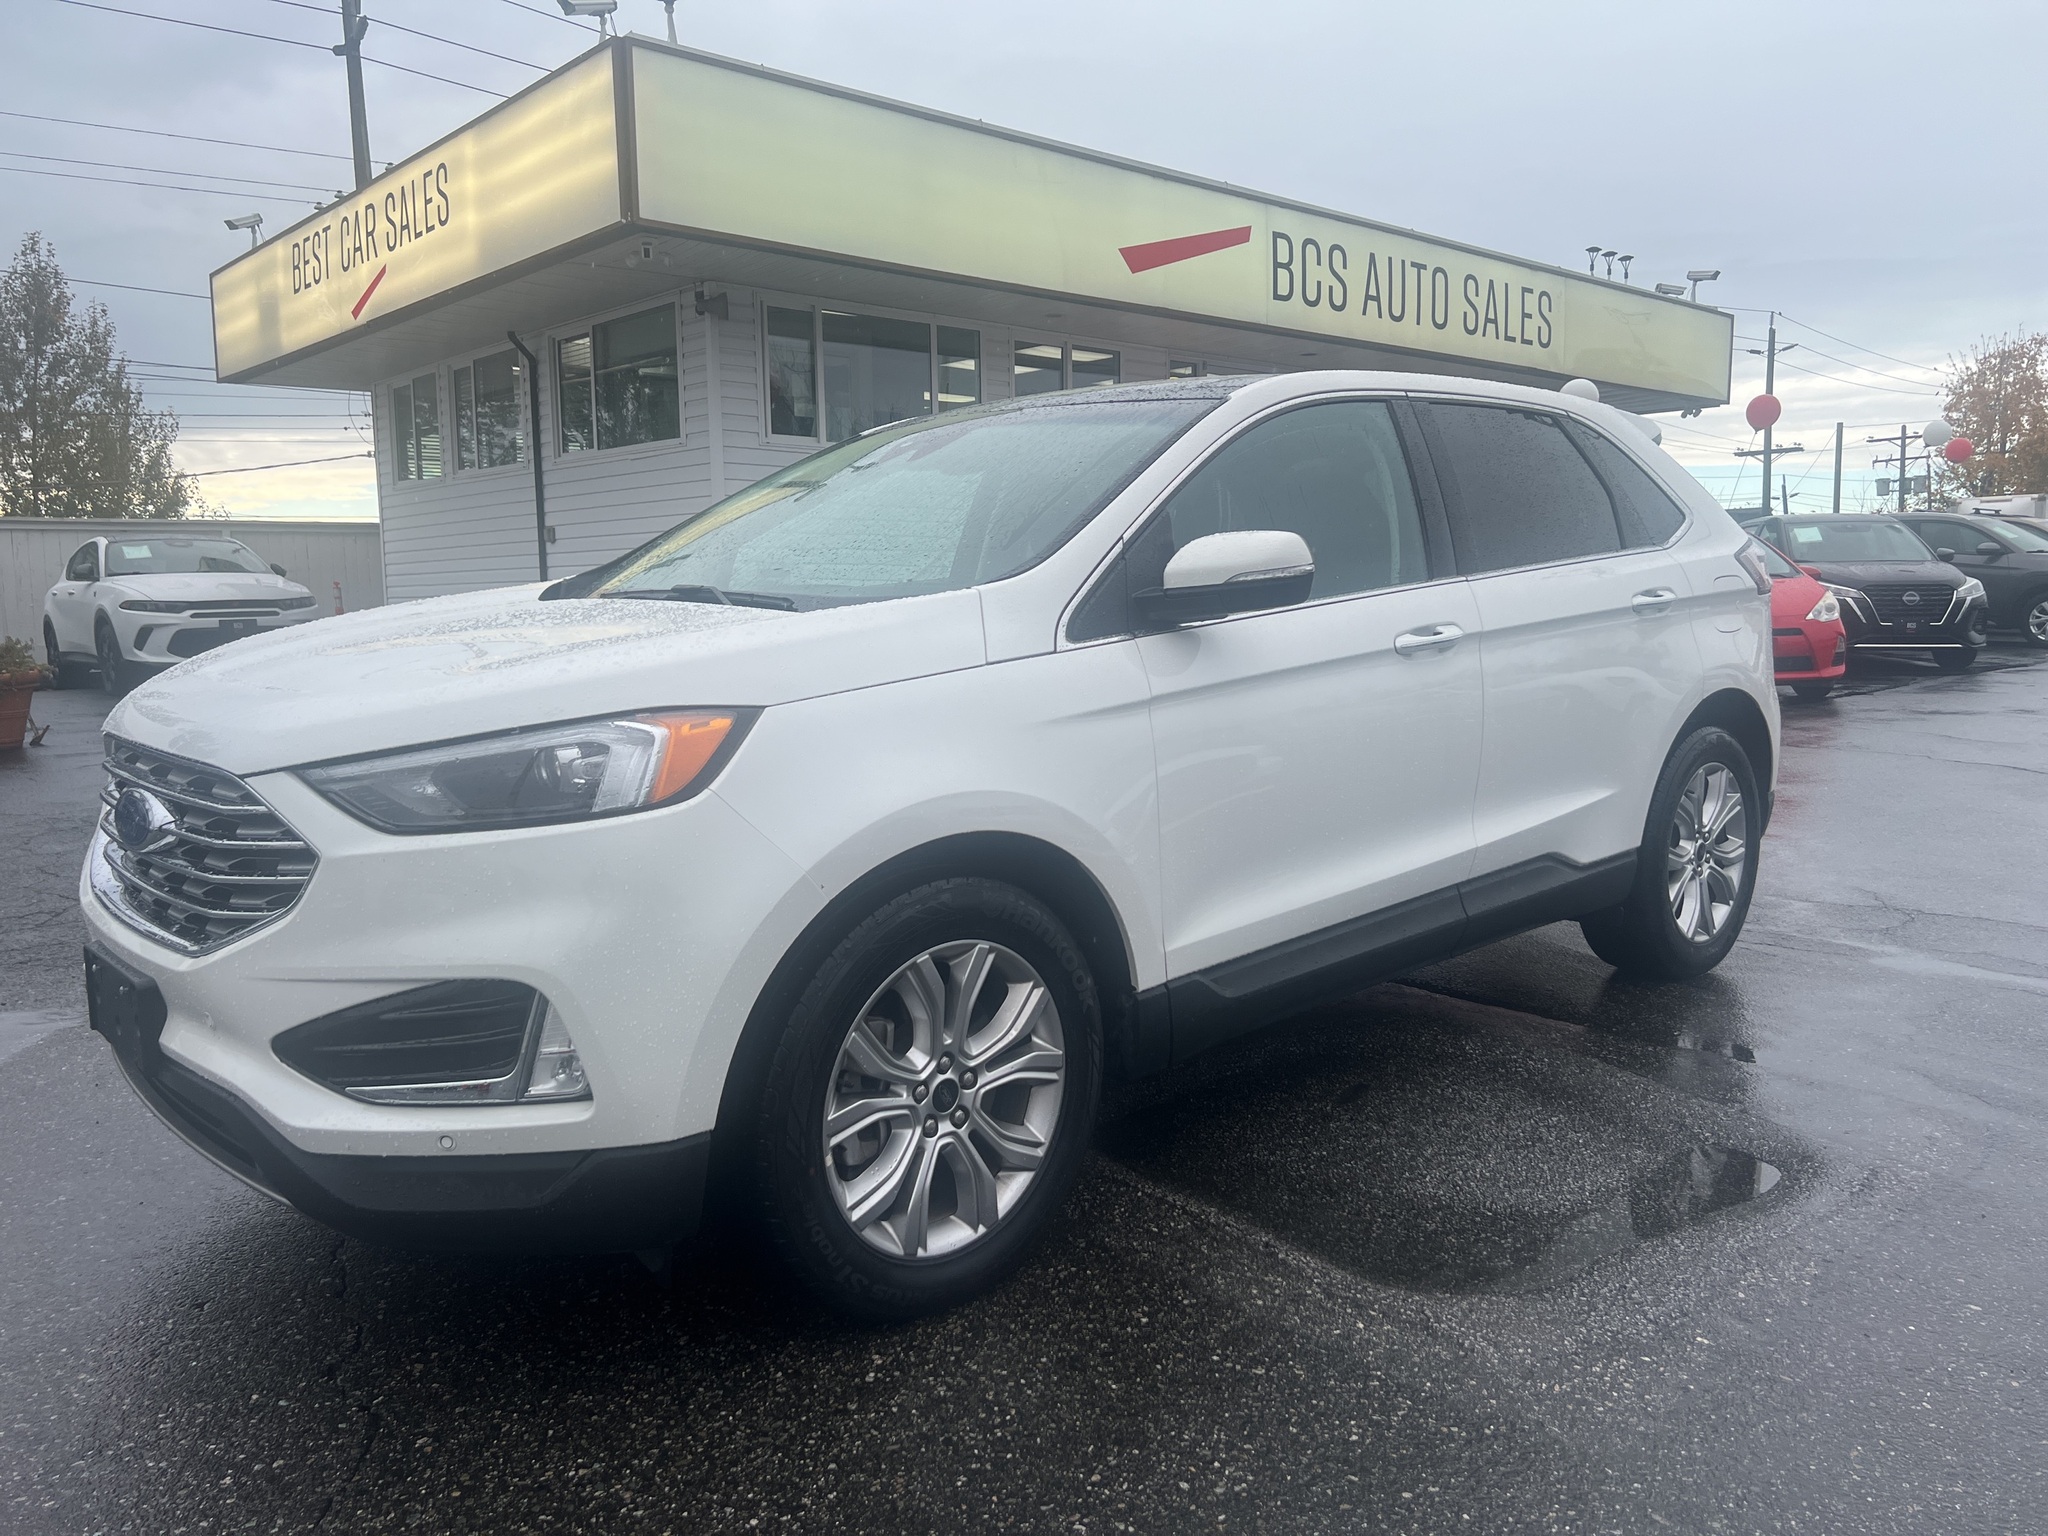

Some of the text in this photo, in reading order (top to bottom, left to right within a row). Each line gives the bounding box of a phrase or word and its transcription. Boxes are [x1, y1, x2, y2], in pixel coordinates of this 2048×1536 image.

[292, 162, 450, 295] BEST CAR SALES
[1272, 230, 1552, 349] BCS AUTO SALES
